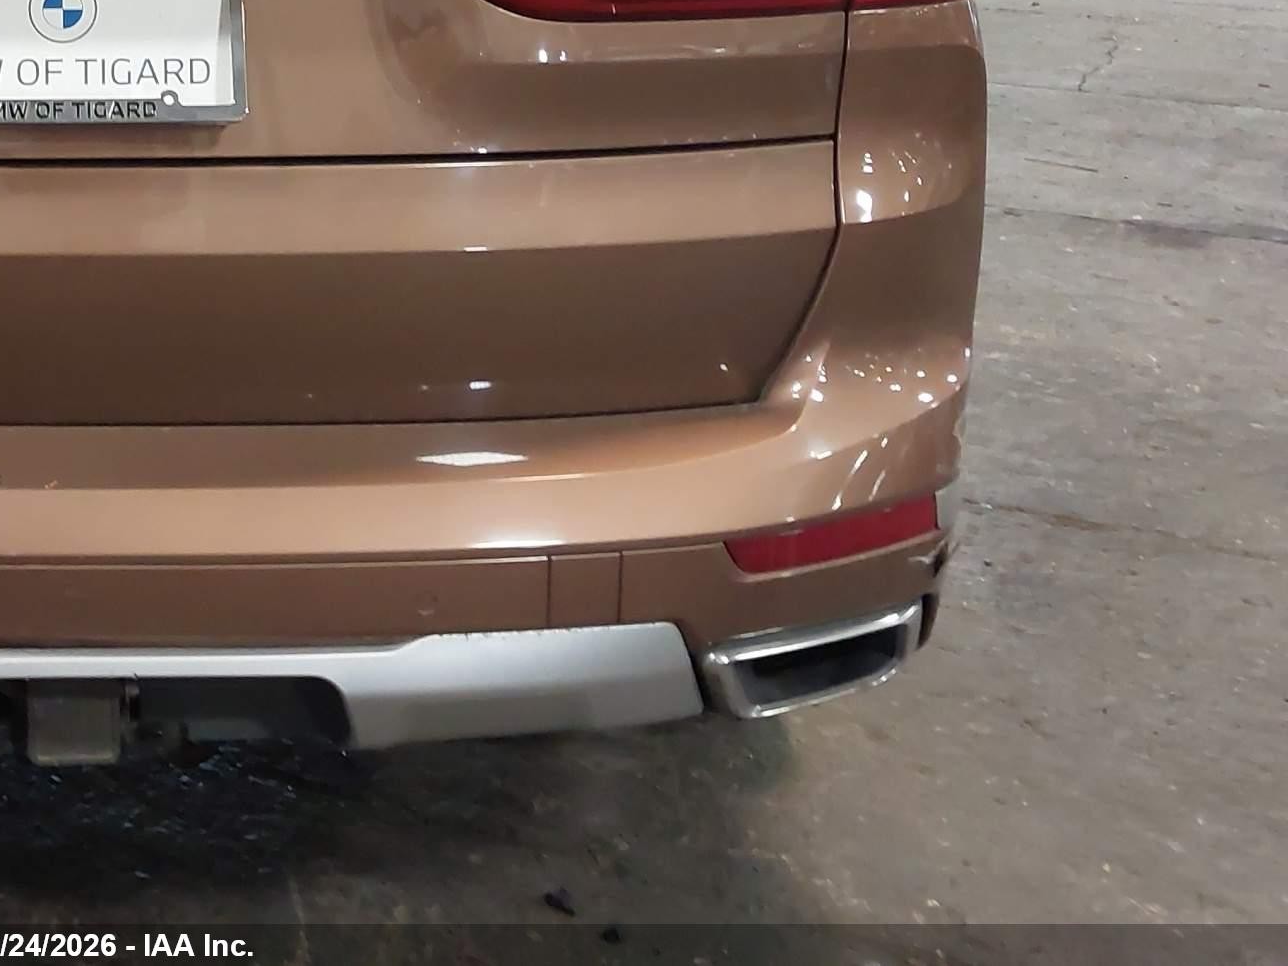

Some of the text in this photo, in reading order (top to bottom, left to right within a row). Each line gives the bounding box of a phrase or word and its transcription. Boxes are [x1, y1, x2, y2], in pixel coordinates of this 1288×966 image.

[17, 59, 64, 86] OF
[75, 58, 211, 85] TIGARD
[35, 102, 64, 120] OF
[71, 101, 158, 119] TIGARD
